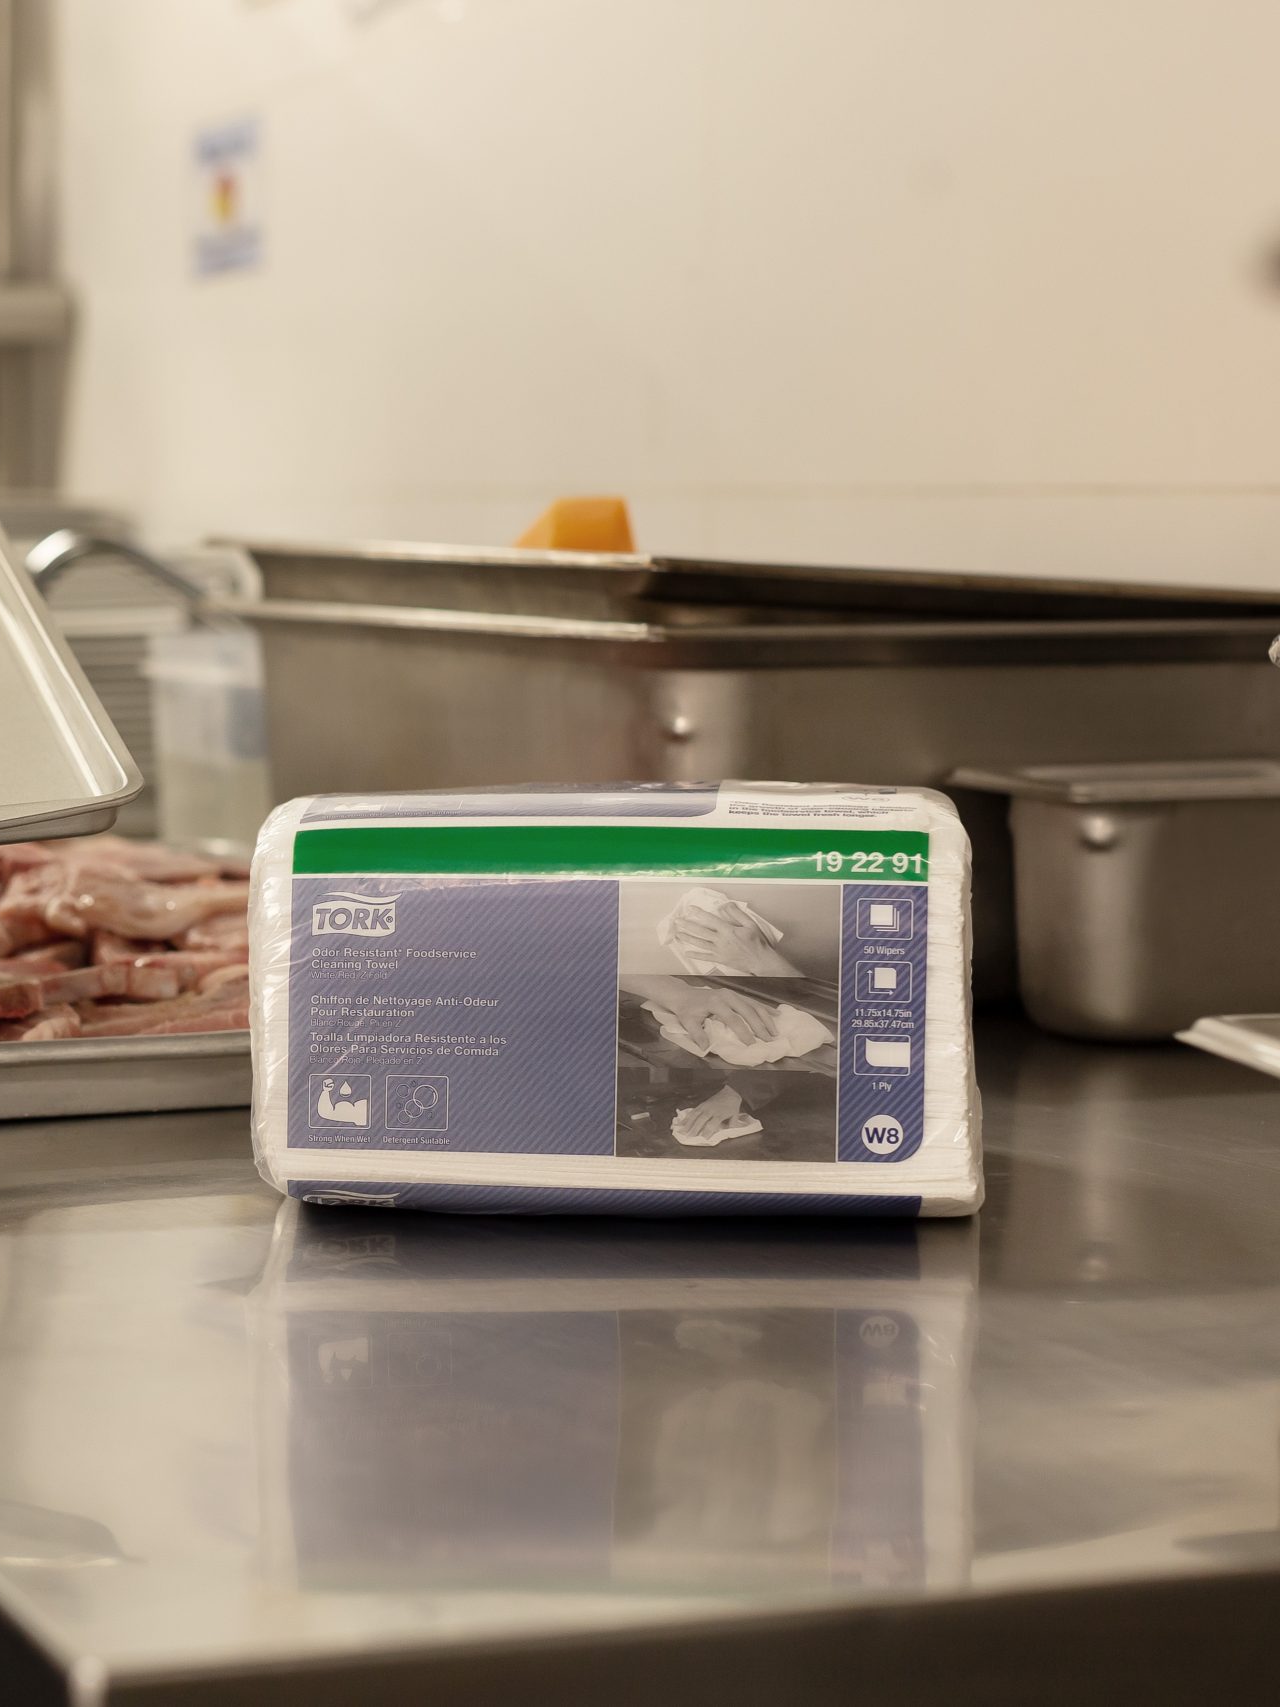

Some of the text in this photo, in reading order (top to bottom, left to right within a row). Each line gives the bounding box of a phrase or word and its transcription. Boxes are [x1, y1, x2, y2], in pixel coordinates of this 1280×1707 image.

[814, 851, 922, 874] 19 22 91
[312, 948, 342, 958] Odor
[406, 948, 478, 959] Foodservice
[863, 946, 906, 956] 50 Wipers
[311, 960, 398, 972] Cleaning Towel
[310, 995, 500, 1008] Chiffon de Nettoyage Anti-Odeur
[310, 1008, 415, 1018] Pour Restauration
[854, 1008, 912, 1018] 11.75x14.75in
[851, 1018, 915, 1029] 29.85x37.47cm
[310, 1032, 507, 1045] Toalla Limpiadora Resistente a los
[310, 1044, 500, 1056] Olores Para Servicios de Comida
[872, 1082, 892, 1092] 1 Ply
[308, 1134, 332, 1144] Strong
[334, 1135, 355, 1143] When
[382, 1136, 450, 1145] Detergent Suitable
[864, 1126, 900, 1144] W8
